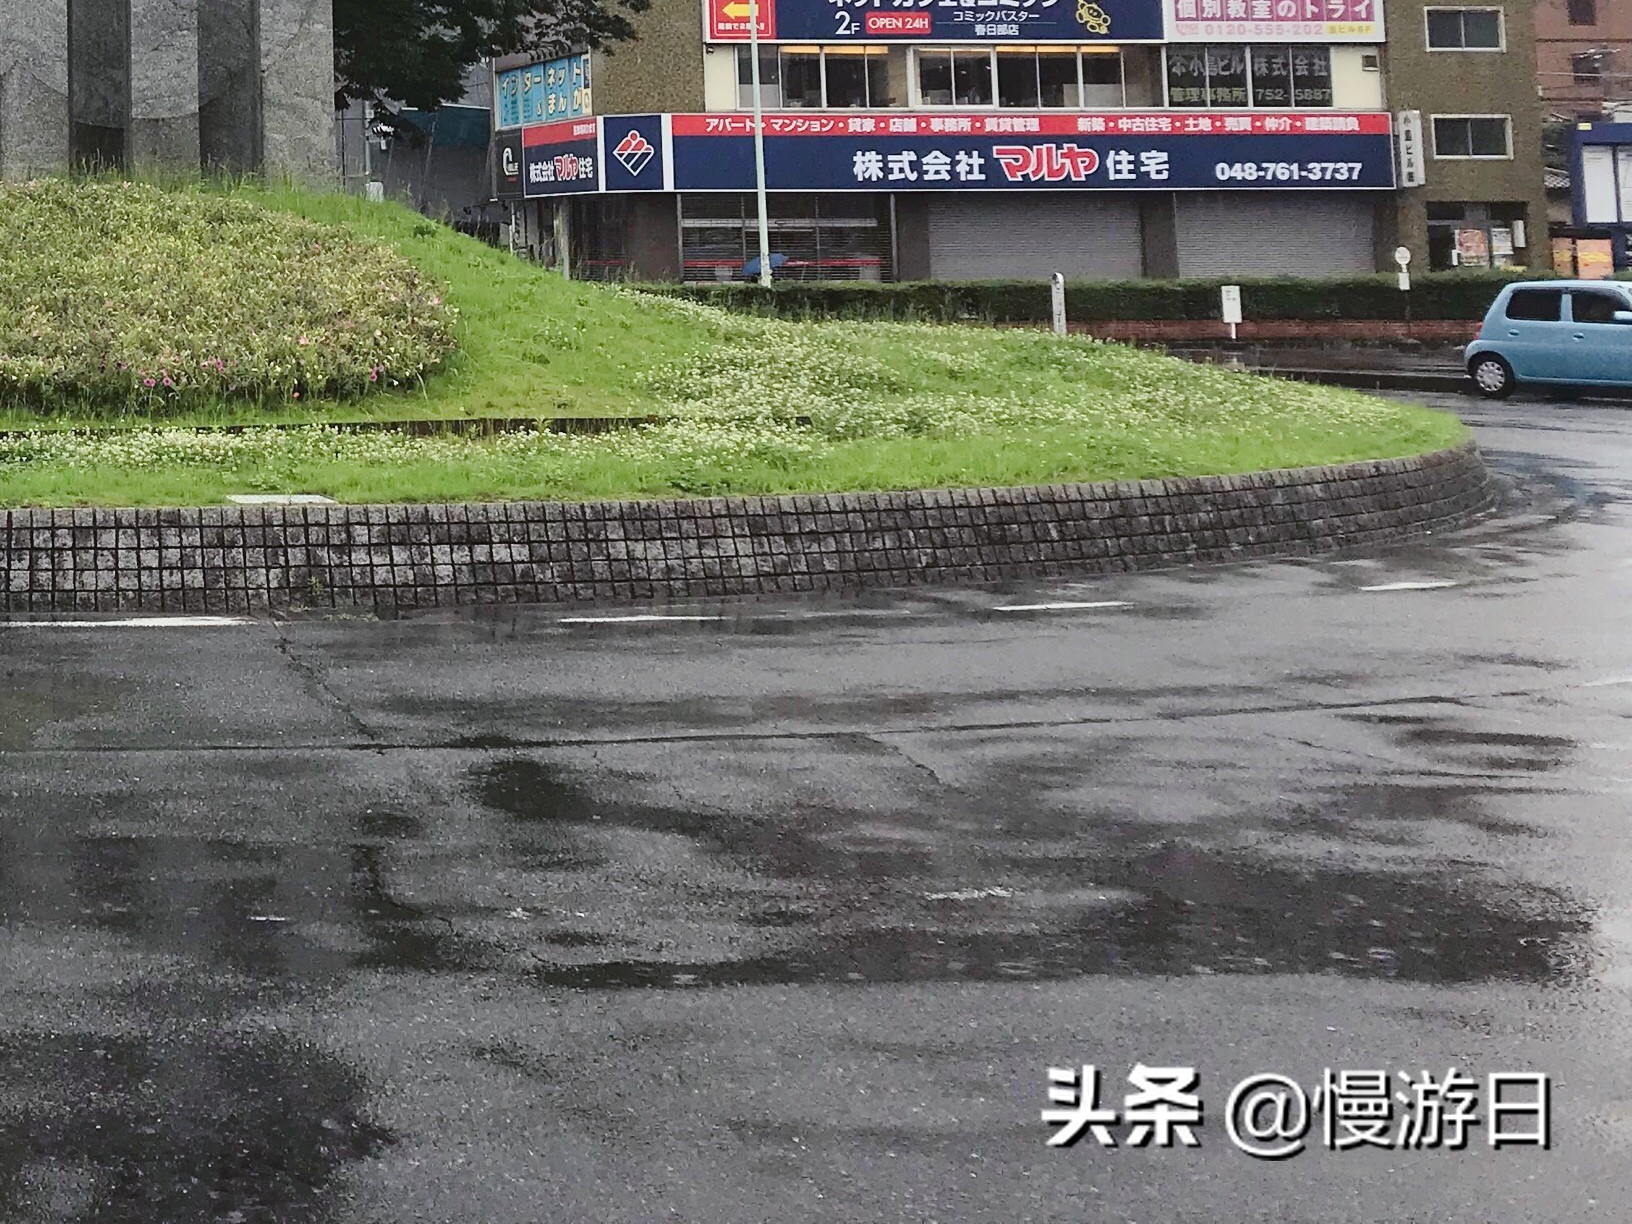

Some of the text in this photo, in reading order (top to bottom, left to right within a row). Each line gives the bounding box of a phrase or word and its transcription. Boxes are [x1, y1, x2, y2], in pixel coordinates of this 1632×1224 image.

[834, 11, 929, 35] 2F OPEN 24H
[953, 11, 1040, 22] コミックバスター
[975, 24, 1019, 36] 春日部店
[1205, 24, 1324, 36] 0120-555-202
[502, 61, 581, 97] インターネット
[1215, 162, 1363, 181] 048-761-3737
